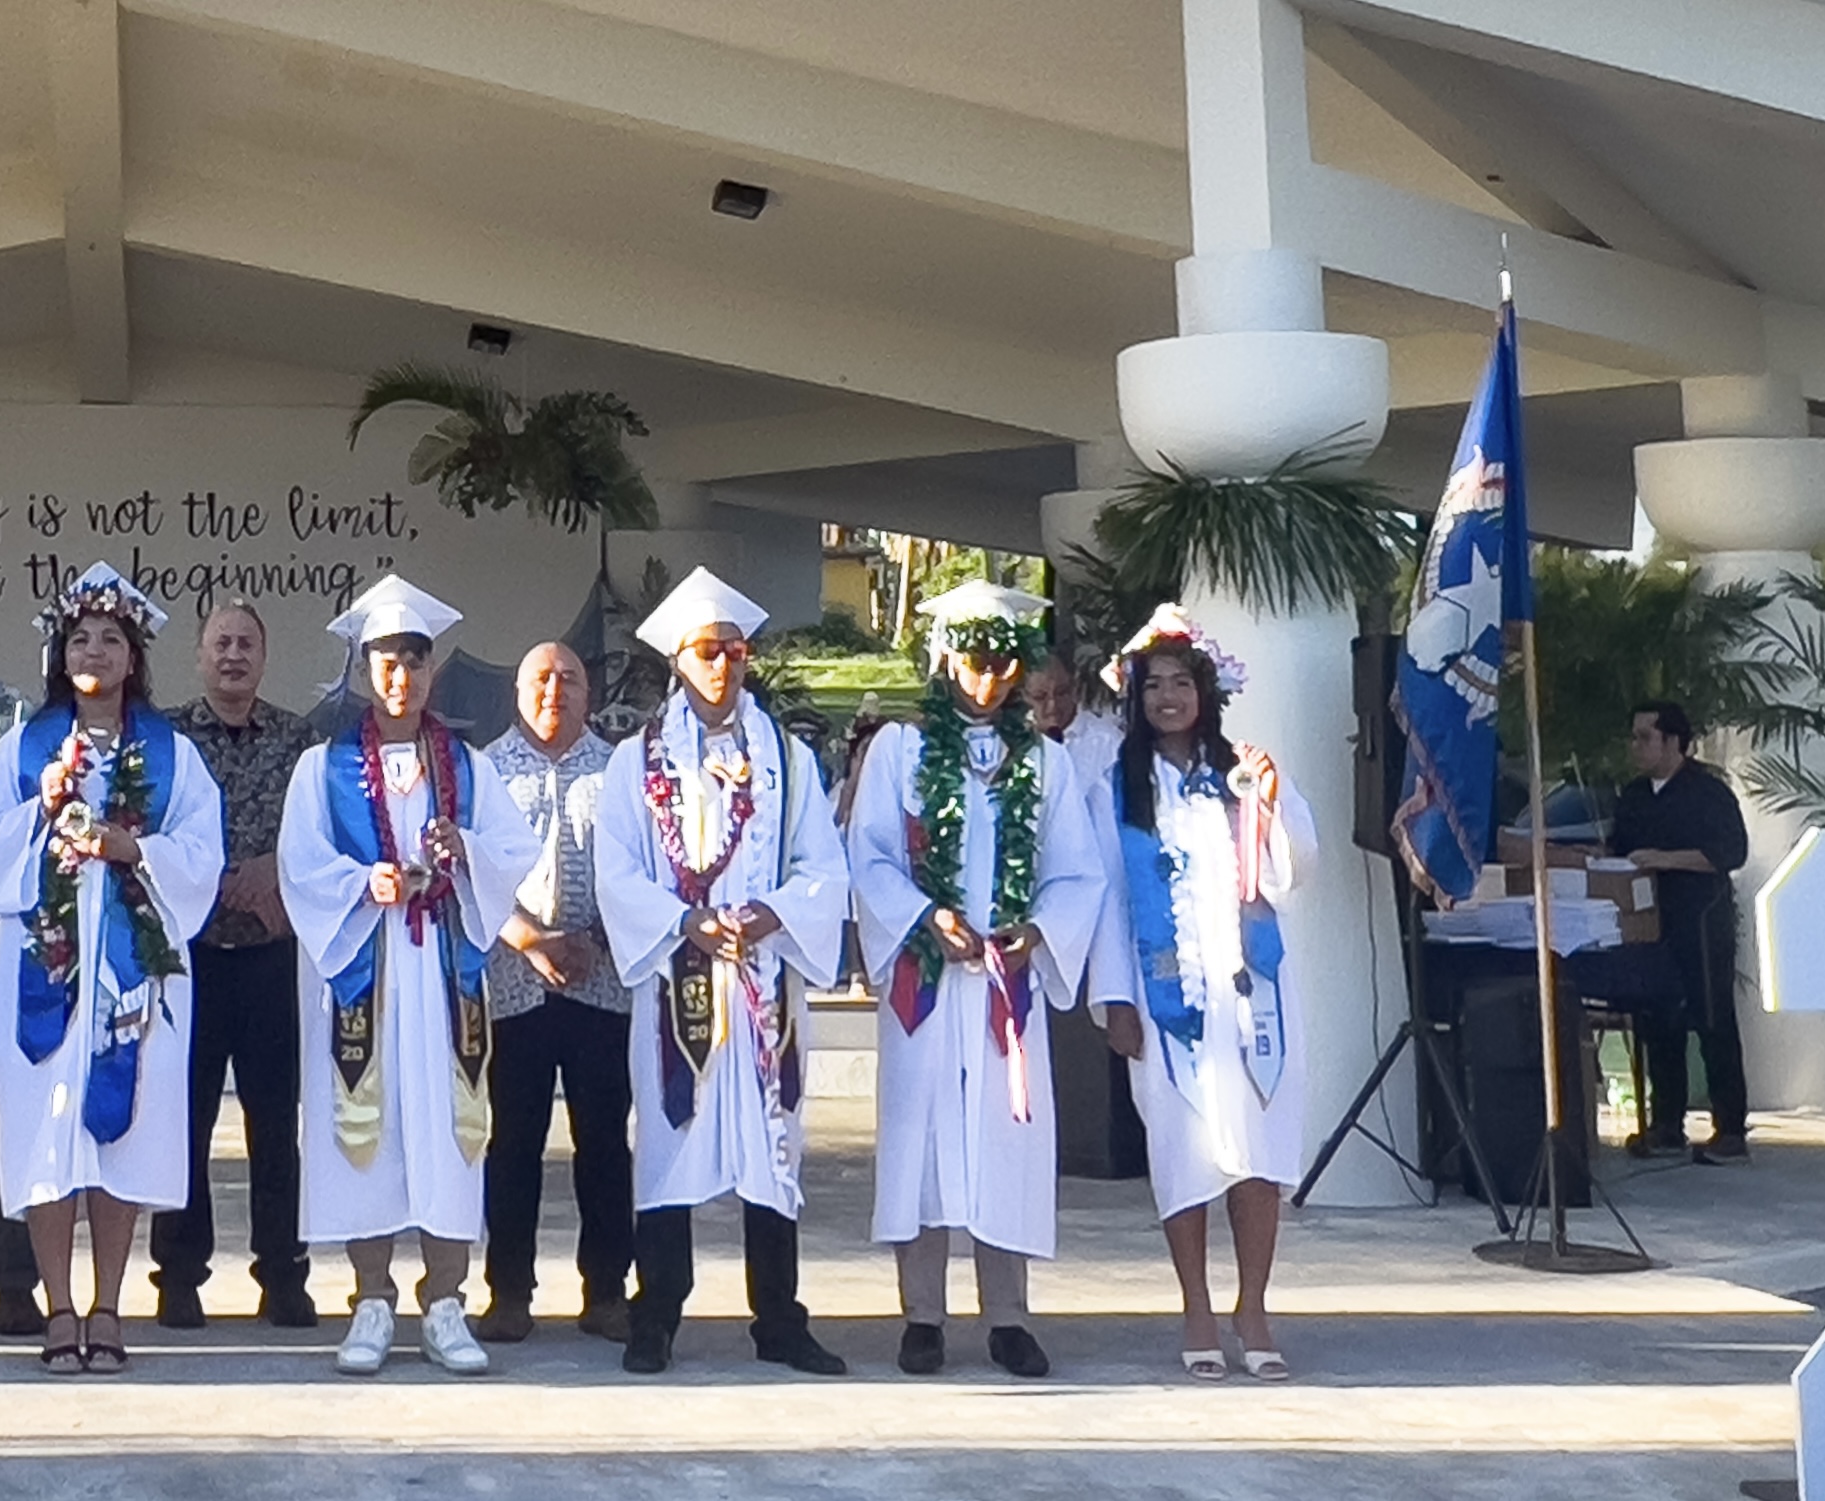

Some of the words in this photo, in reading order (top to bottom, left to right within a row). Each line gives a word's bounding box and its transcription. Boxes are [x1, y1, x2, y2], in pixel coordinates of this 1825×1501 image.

[28, 493, 67, 537] is
[87, 489, 164, 537] not
[181, 491, 269, 543] the
[288, 484, 419, 542] limit,
[687, 1024, 709, 1042] 20
[340, 1044, 365, 1062] 20
